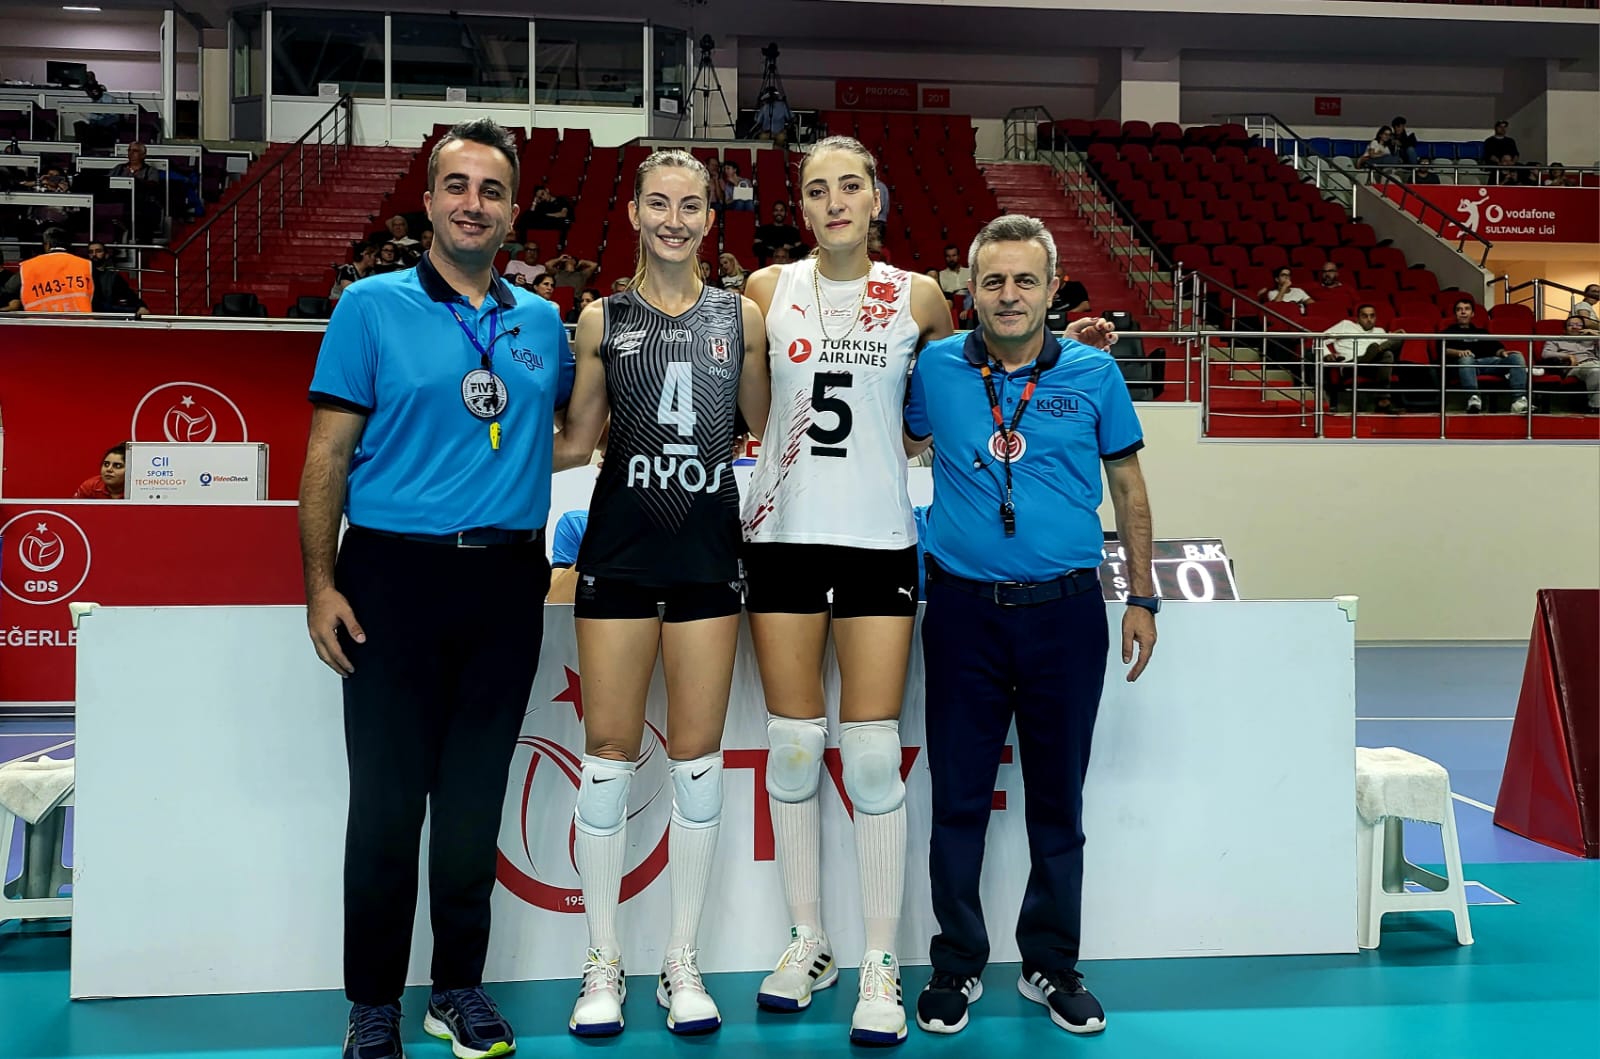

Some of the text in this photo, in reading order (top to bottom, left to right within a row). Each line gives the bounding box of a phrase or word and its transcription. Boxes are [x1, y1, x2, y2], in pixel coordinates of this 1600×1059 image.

[1506, 208, 1555, 219] vodafone
[1485, 226, 1535, 234] SULTANLAR
[821, 338, 887, 353] TURKISH
[818, 351, 887, 368] AIRLINES
[657, 361, 697, 436] 4
[805, 372, 853, 445] 5
[1182, 544, 1226, 560] BJK
[24, 580, 58, 593] GDS
